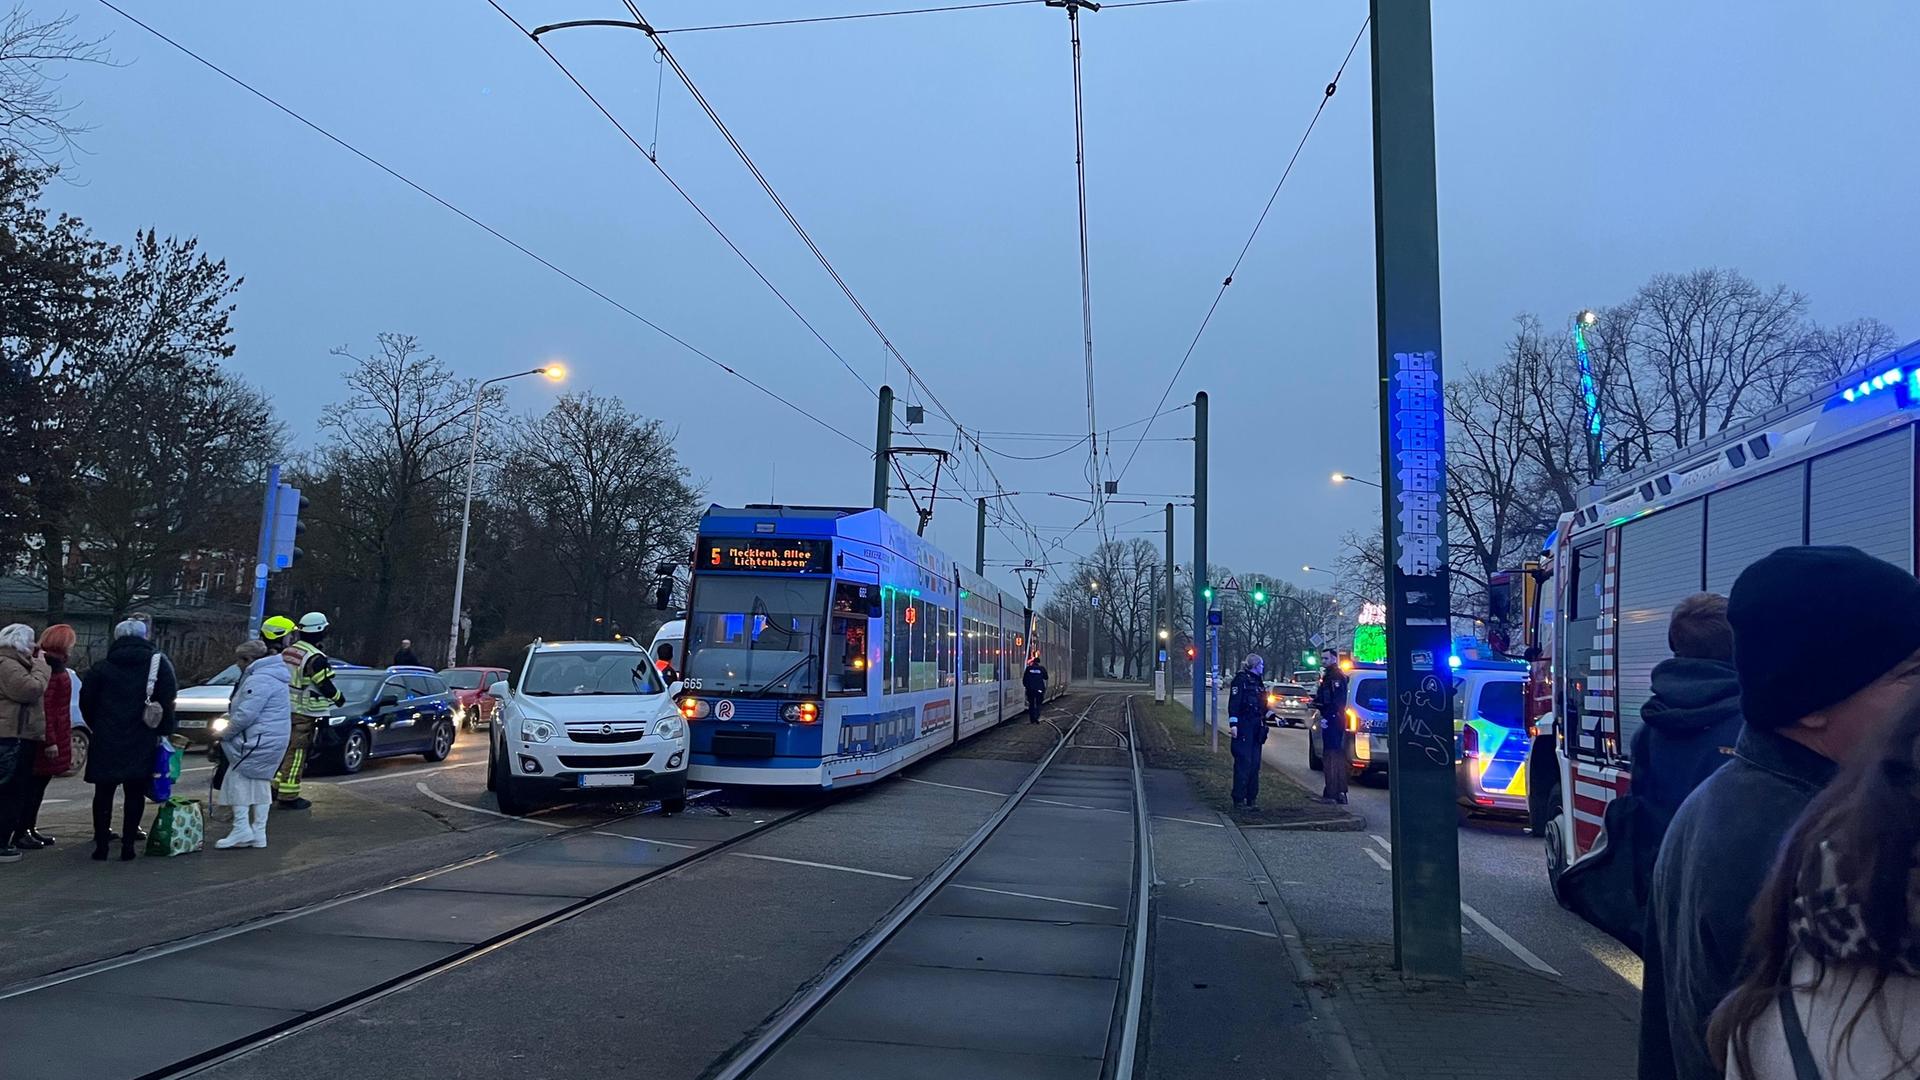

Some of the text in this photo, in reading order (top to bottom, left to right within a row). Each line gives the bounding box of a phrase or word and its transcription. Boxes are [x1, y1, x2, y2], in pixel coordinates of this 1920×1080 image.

[712, 548, 720, 565] 5
[784, 550, 811, 559] Allee
[735, 557, 806, 567] Lichtenhagen
[684, 678, 702, 689] 665
